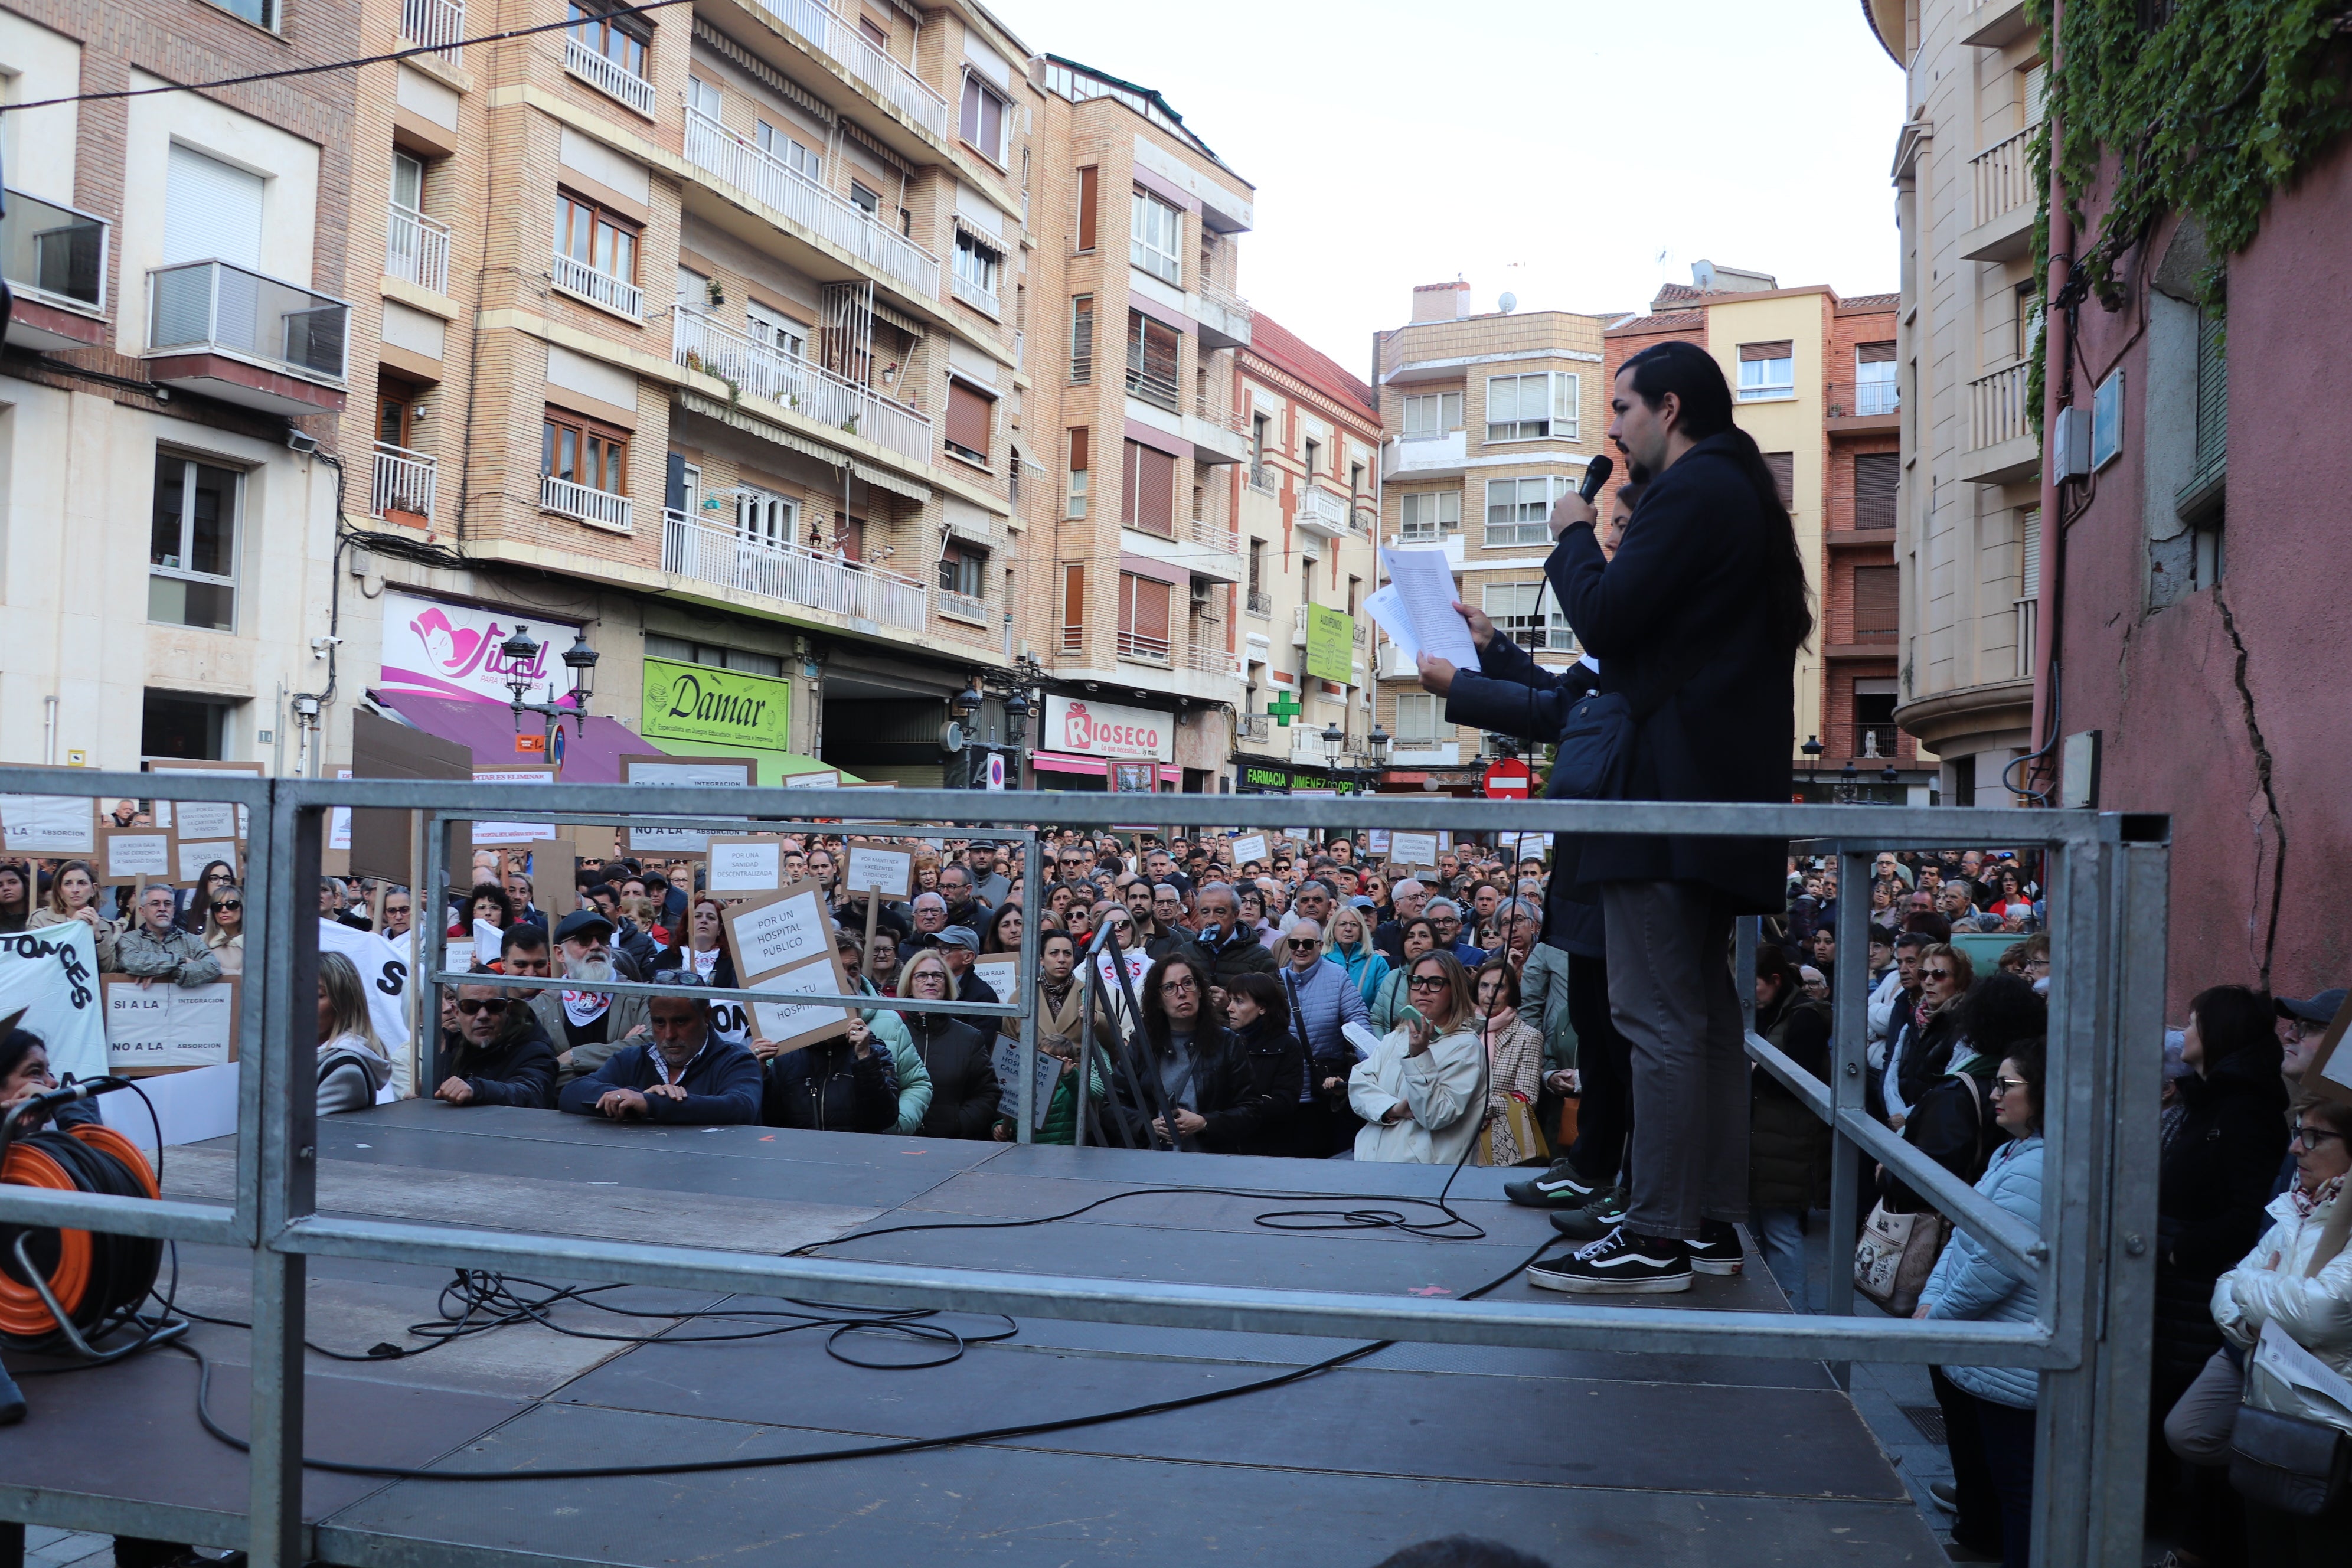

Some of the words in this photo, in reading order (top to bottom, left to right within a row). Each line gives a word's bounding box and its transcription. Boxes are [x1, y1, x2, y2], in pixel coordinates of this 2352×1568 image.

[480, 675, 498, 684] PARA
[509, 678, 544, 690] DNSO
[669, 674, 766, 727] Damar
[658, 723, 685, 733] Especialista
[692, 728, 707, 736] Juegos
[708, 729, 731, 738] Educativos
[1067, 716, 1158, 747] RIOSECO
[1247, 769, 1286, 787] FARMACIA
[1291, 775, 1327, 789] JIMÉNEZ
[1338, 780, 1363, 794] OPTIA
[757, 916, 778, 930] POR
[779, 910, 794, 922] UN
[757, 923, 802, 945] HOSPITAL
[763, 937, 803, 958] PÚBLICO
[803, 983, 816, 993] TU
[114, 1001, 126, 1009] SI
[143, 1001, 159, 1009] LA
[777, 1004, 816, 1020] HOSPI
[112, 1043, 130, 1051] NO
[135, 1043, 143, 1051] A
